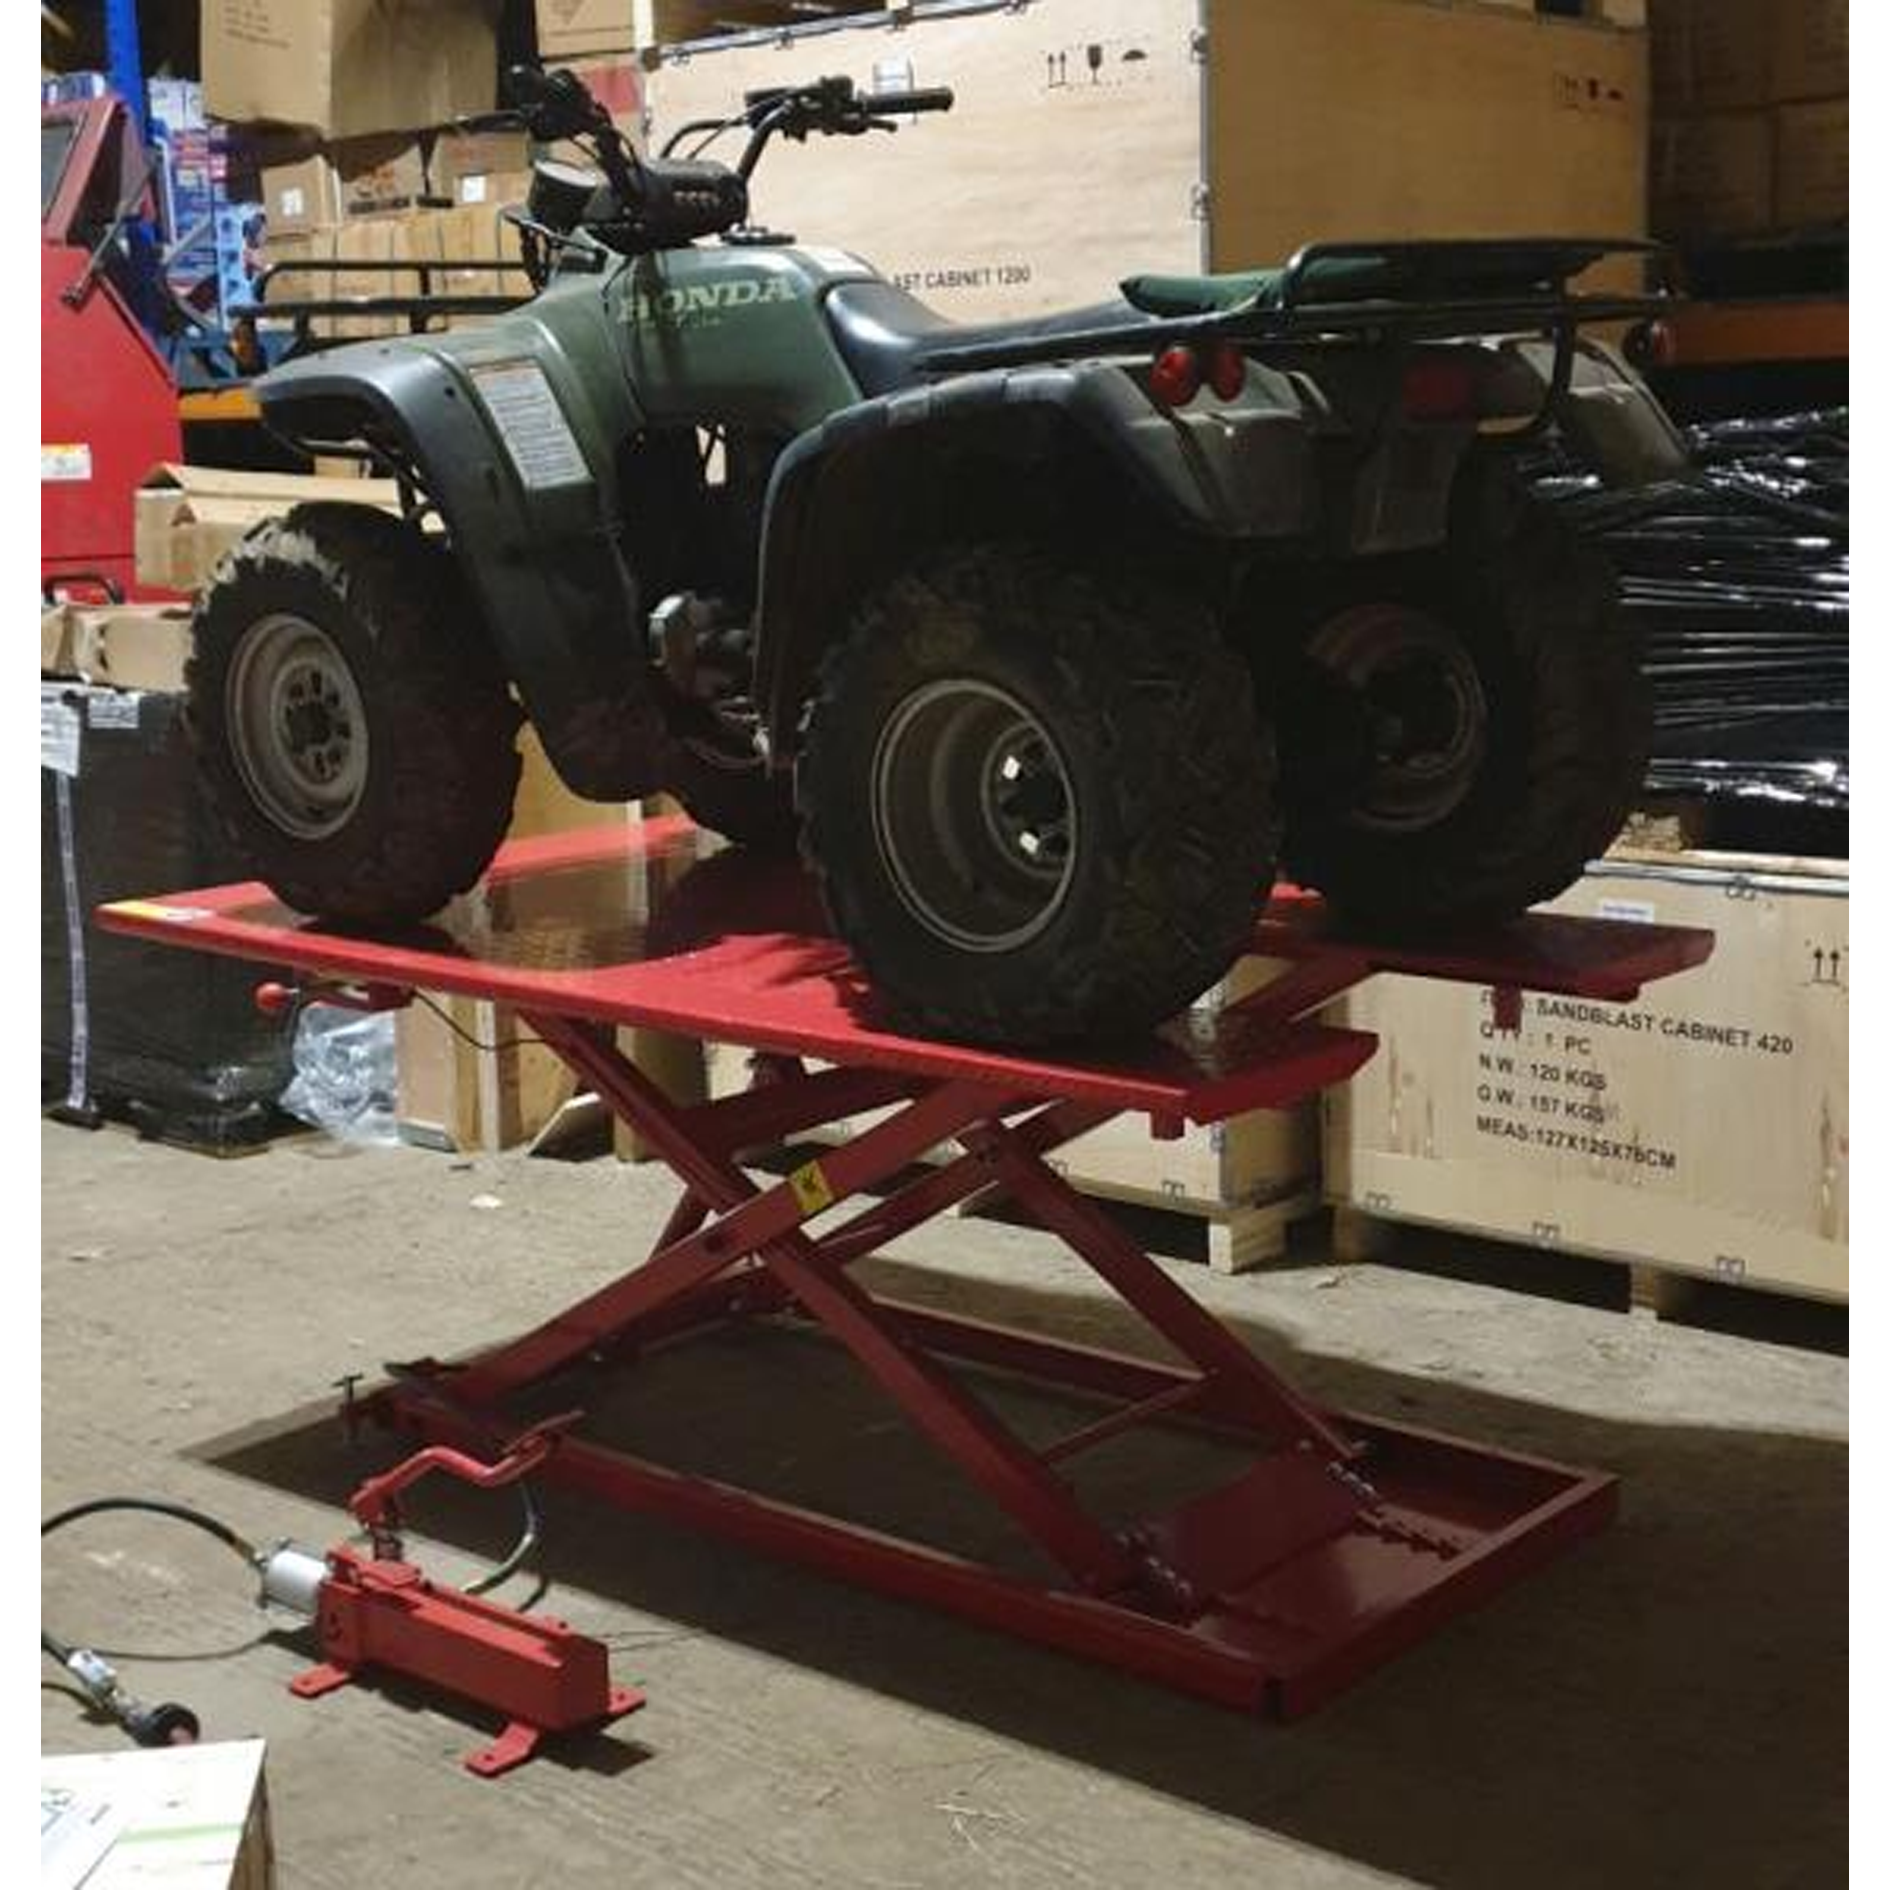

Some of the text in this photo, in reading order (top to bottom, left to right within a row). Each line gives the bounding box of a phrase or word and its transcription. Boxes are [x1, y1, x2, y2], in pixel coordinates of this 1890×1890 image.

[925, 267, 991, 289] CABINET
[617, 276, 798, 326] HONDA
[1536, 998, 1653, 1032] SANDBLAST
[1659, 1017, 1751, 1048] CABINET
[1757, 1033, 1794, 1055] 420
[1564, 1036, 1591, 1055] PC
[1530, 1063, 1561, 1082] 120
[1565, 1069, 1607, 1091] KGS
[1530, 1095, 1561, 1114] 157
[1564, 1101, 1605, 1125] KGS
